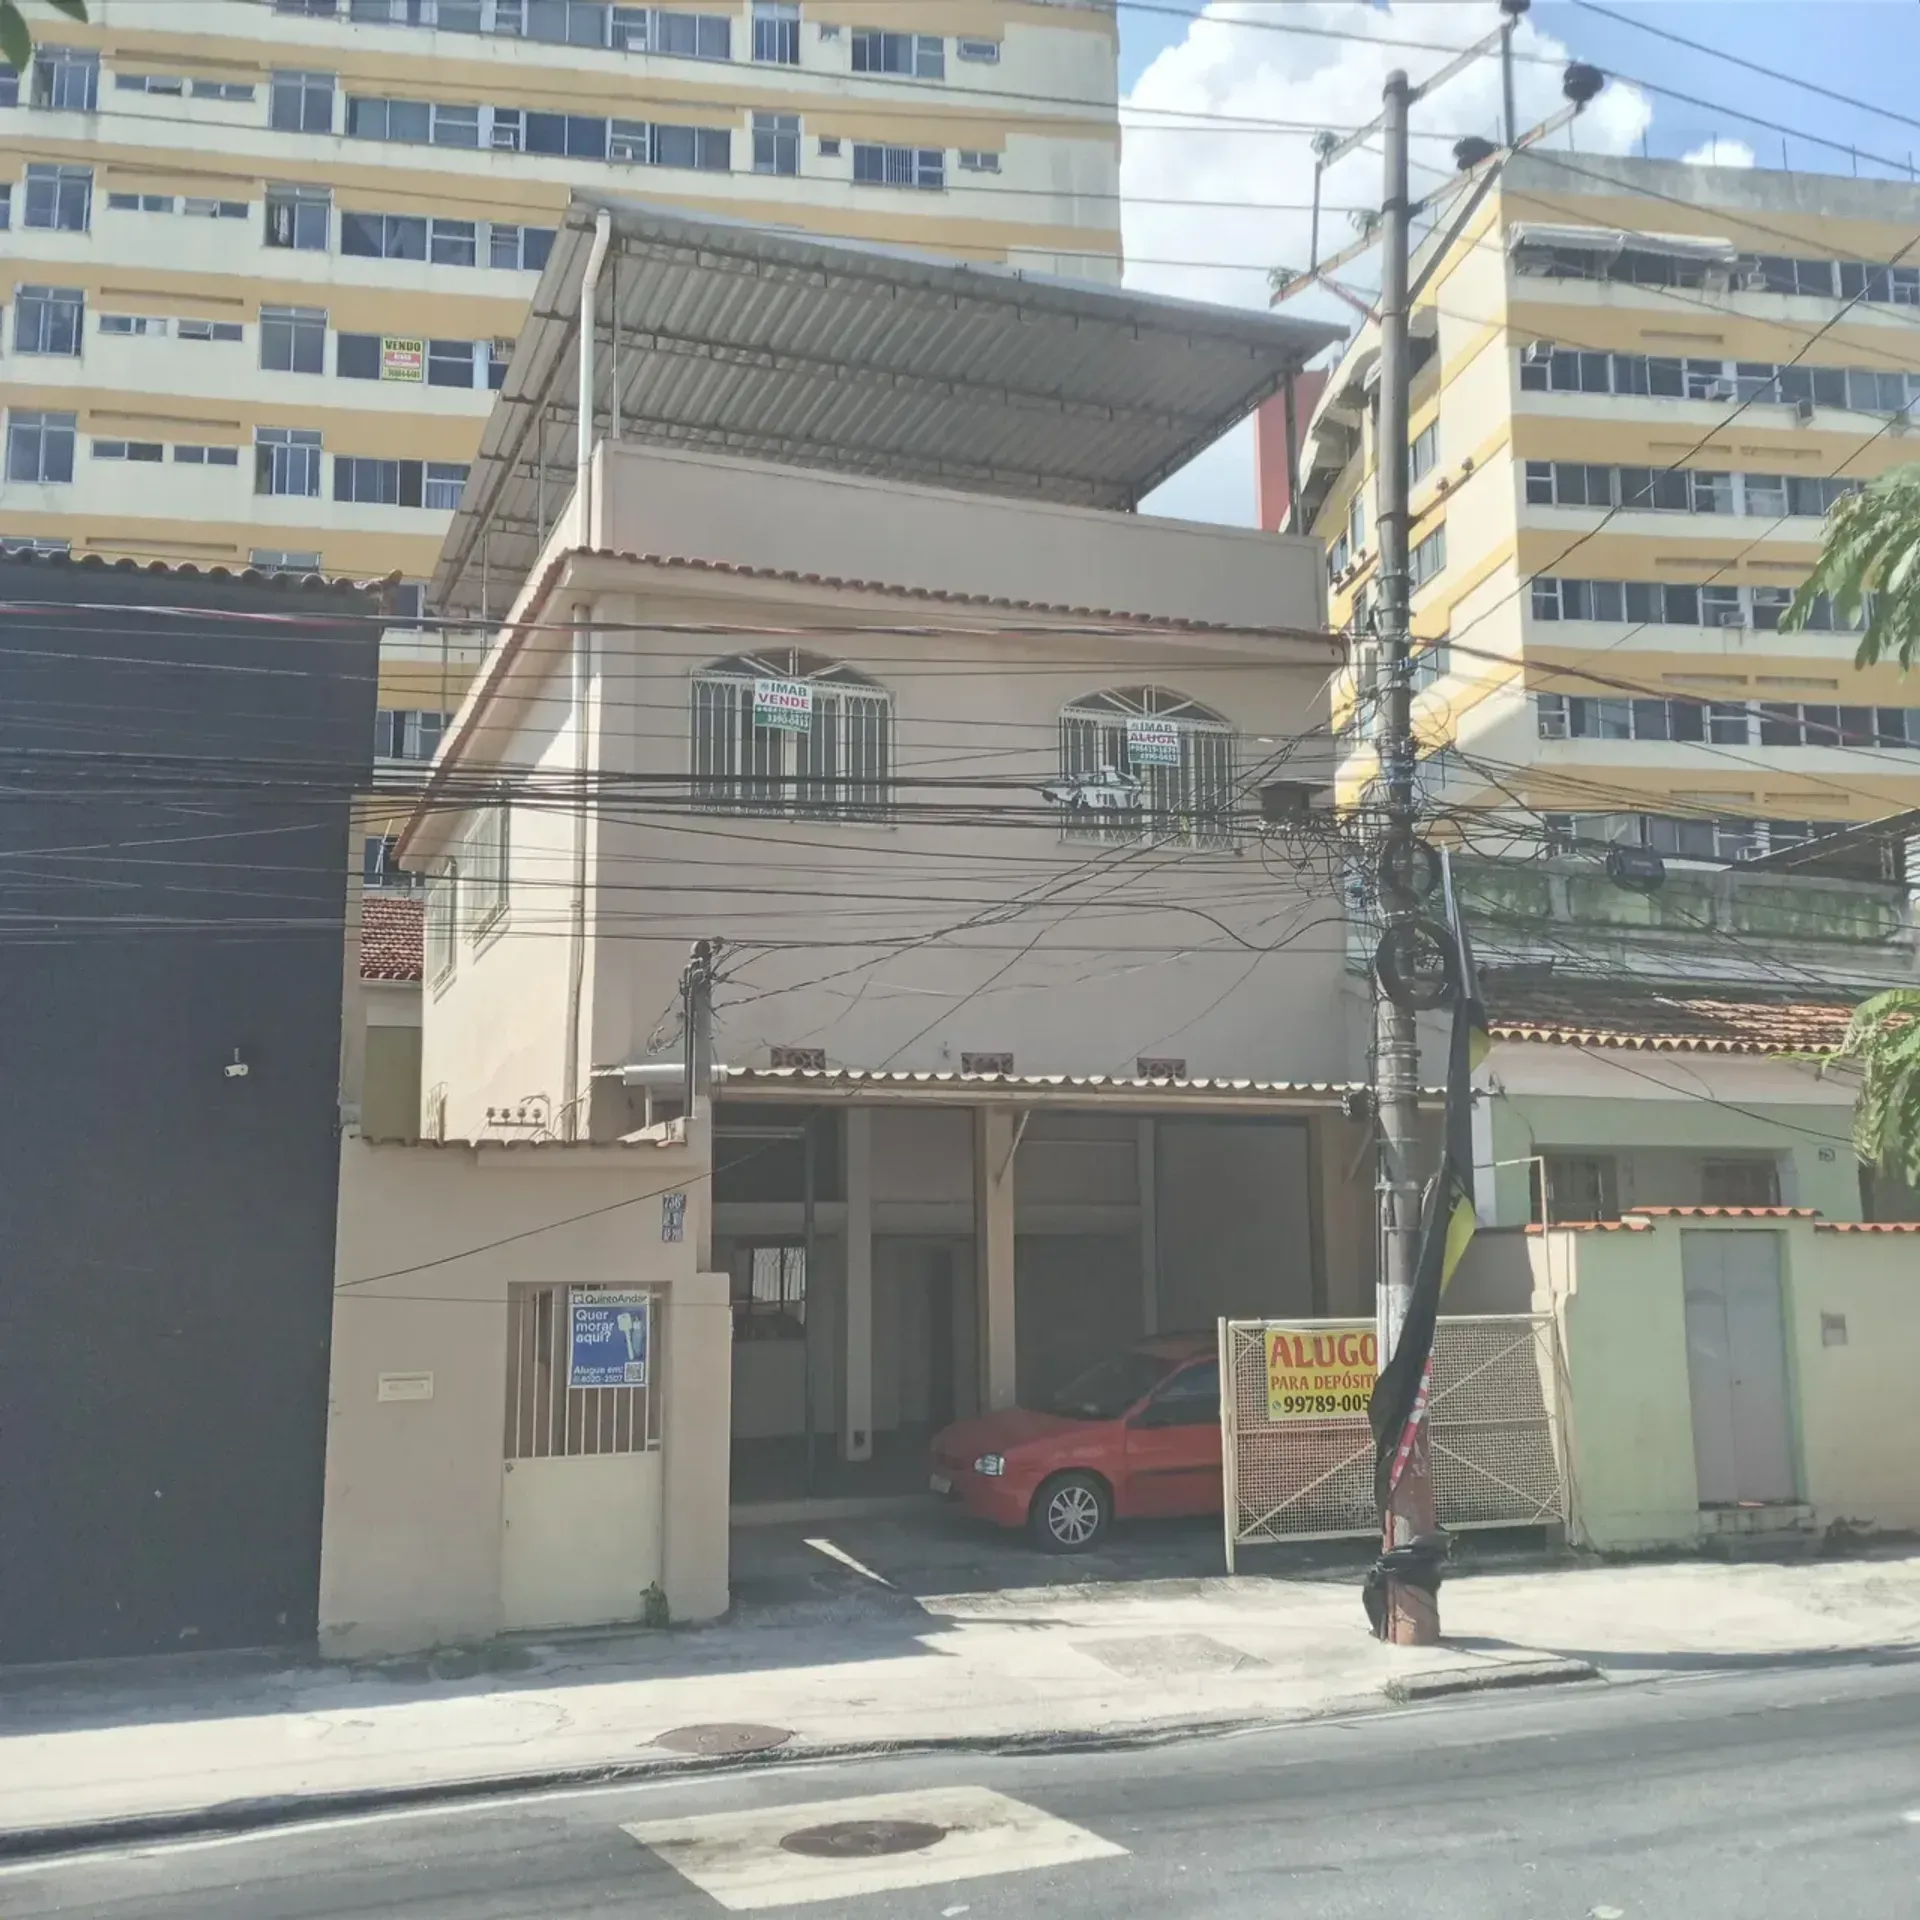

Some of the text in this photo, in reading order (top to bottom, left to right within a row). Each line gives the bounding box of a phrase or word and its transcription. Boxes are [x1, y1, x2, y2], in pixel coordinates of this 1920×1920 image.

[385, 340, 421, 352] VENDO
[771, 682, 807, 697] IMAB
[758, 693, 809, 709] VENDE
[1140, 722, 1173, 733] IMAB
[1130, 732, 1176, 745] ALUGA
[585, 1294, 648, 1304] QuintoAndar
[576, 1309, 609, 1321] Quer
[576, 1322, 615, 1332] morar
[576, 1330, 611, 1345] aqui?
[1270, 1333, 1378, 1368] ALUGO
[574, 1366, 605, 1376] Alugue
[1271, 1371, 1378, 1390] PARA DEPÓSIT
[1284, 1394, 1371, 1413] 99789-005
